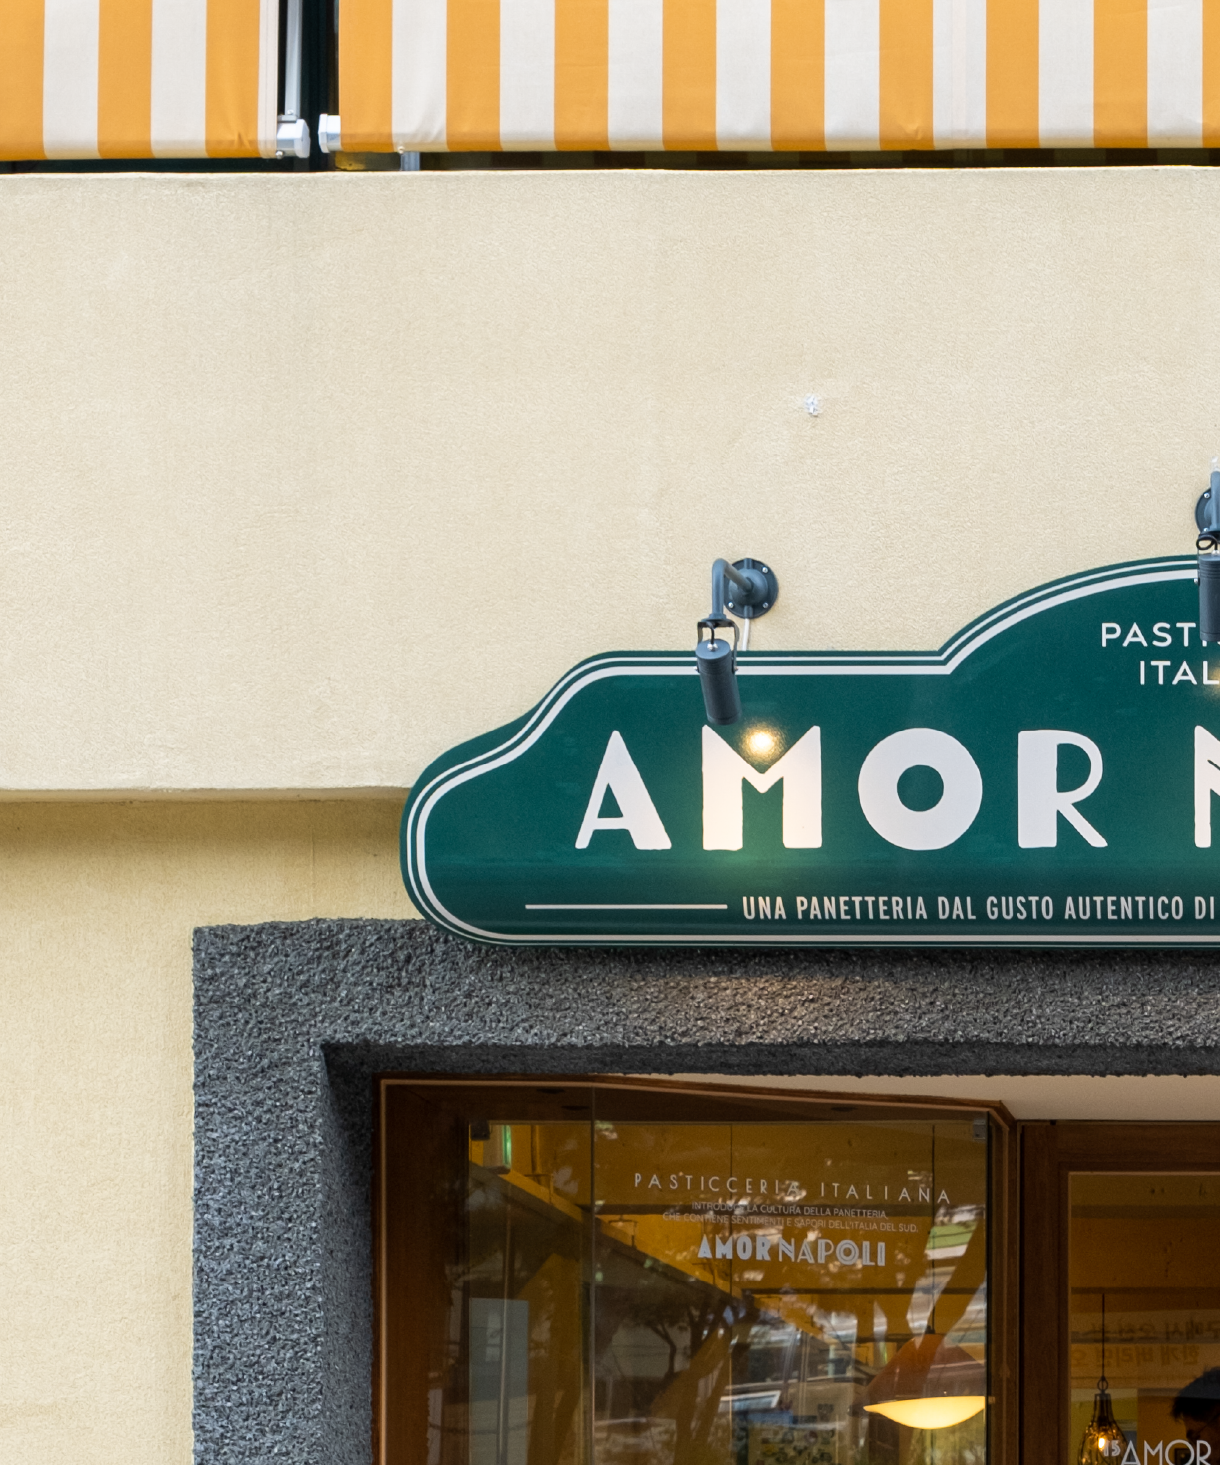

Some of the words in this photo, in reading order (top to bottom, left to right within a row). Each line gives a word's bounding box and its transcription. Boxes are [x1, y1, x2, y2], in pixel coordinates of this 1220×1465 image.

[574, 724, 1108, 852] AMOR
[742, 895, 787, 921] UNA
[796, 895, 928, 921] PANETTERIA
[938, 895, 977, 921] DAL
[986, 895, 1053, 921] GUSTO
[1064, 895, 1184, 921] AUTENTICO
[1194, 895, 1215, 921] DI
[634, 1172, 800, 1196] PASTICCERIA
[820, 1181, 951, 1205] ITALIANA
[663, 1212, 681, 1222] CHE
[731, 1215, 785, 1227] SENTIMENTI
[786, 1217, 792, 1227] E
[794, 1218, 828, 1229] SAPORI
[880, 1222, 897, 1232] DEL
[760, 1204, 802, 1216] CULTURA
[804, 1206, 832, 1217] DELLA
[698, 1234, 771, 1261] AMOR
[778, 1236, 886, 1267] NAPOLI
